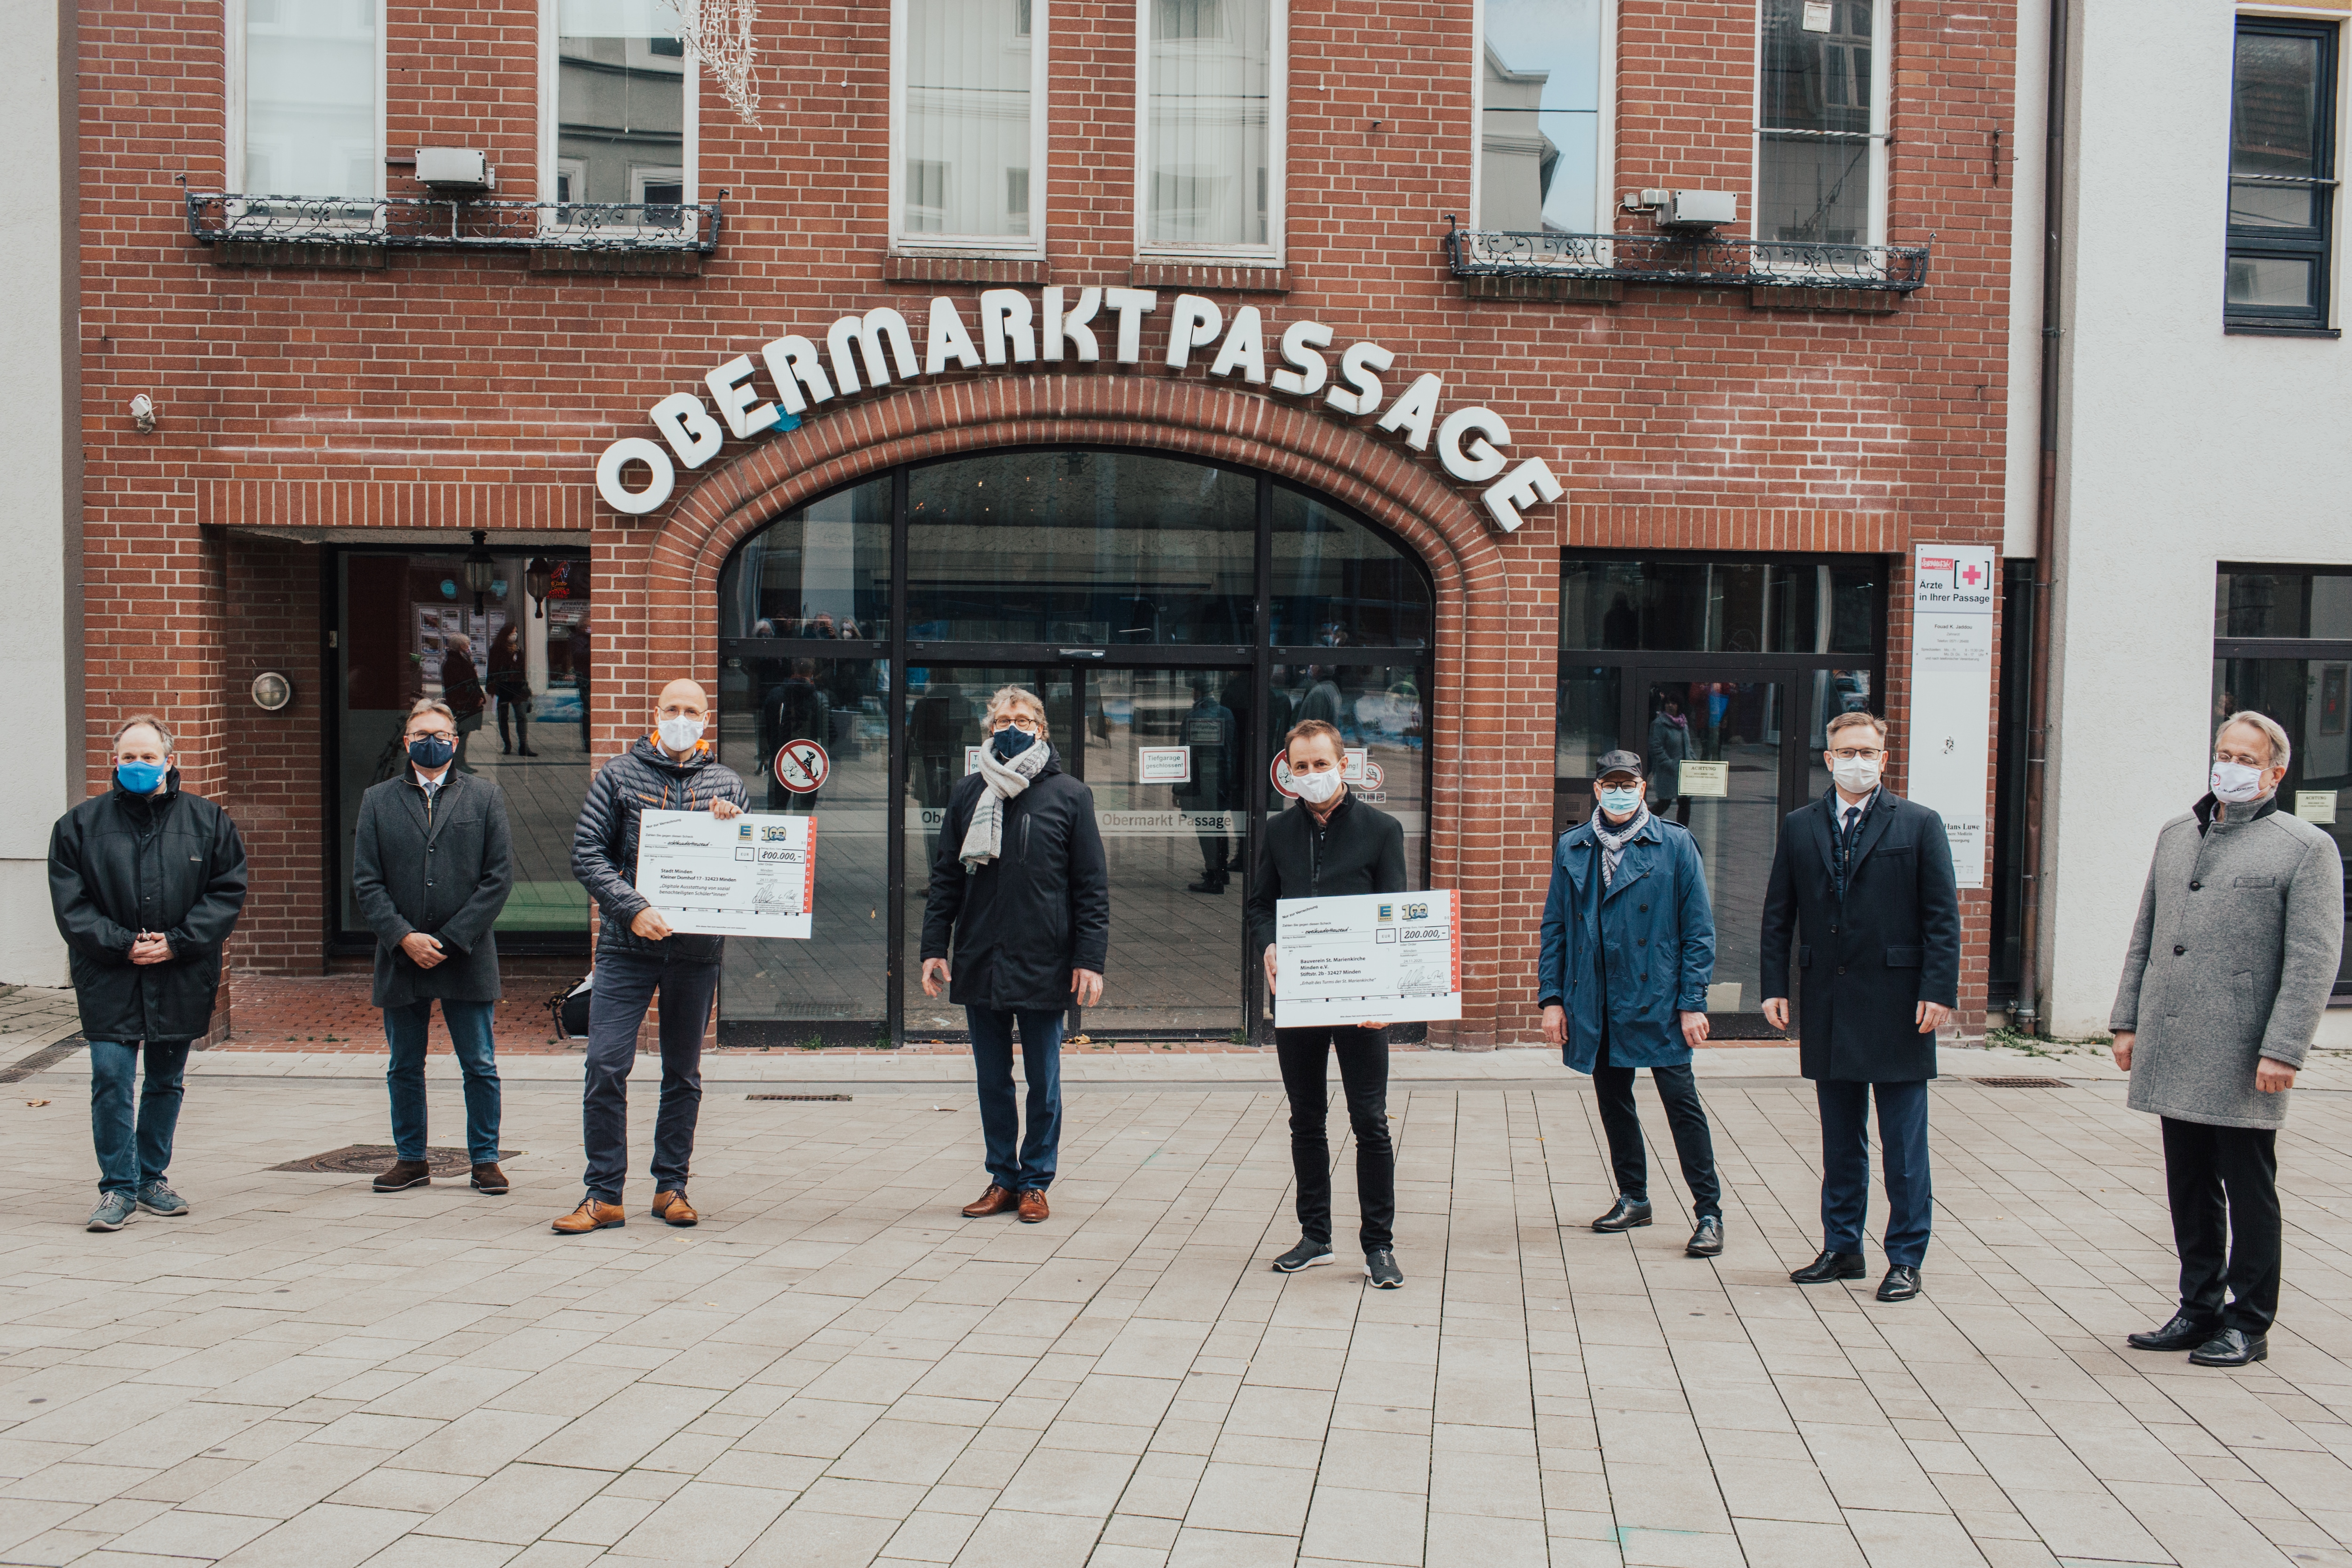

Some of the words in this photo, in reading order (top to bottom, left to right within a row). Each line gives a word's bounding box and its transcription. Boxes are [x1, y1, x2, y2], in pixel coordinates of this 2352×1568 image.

[596, 287, 1157, 515] OBERMARKT
[1165, 294, 1564, 533] PASSAGE
[1920, 579, 1942, 589] Ärzte
[1954, 594, 1989, 604] Passage
[1102, 813, 1173, 826] Obermarkt
[1179, 814, 1231, 829] Passage
[762, 826, 787, 841] 100
[1295, 905, 1318, 915] Verrechnung
[1402, 903, 1428, 920] 100
